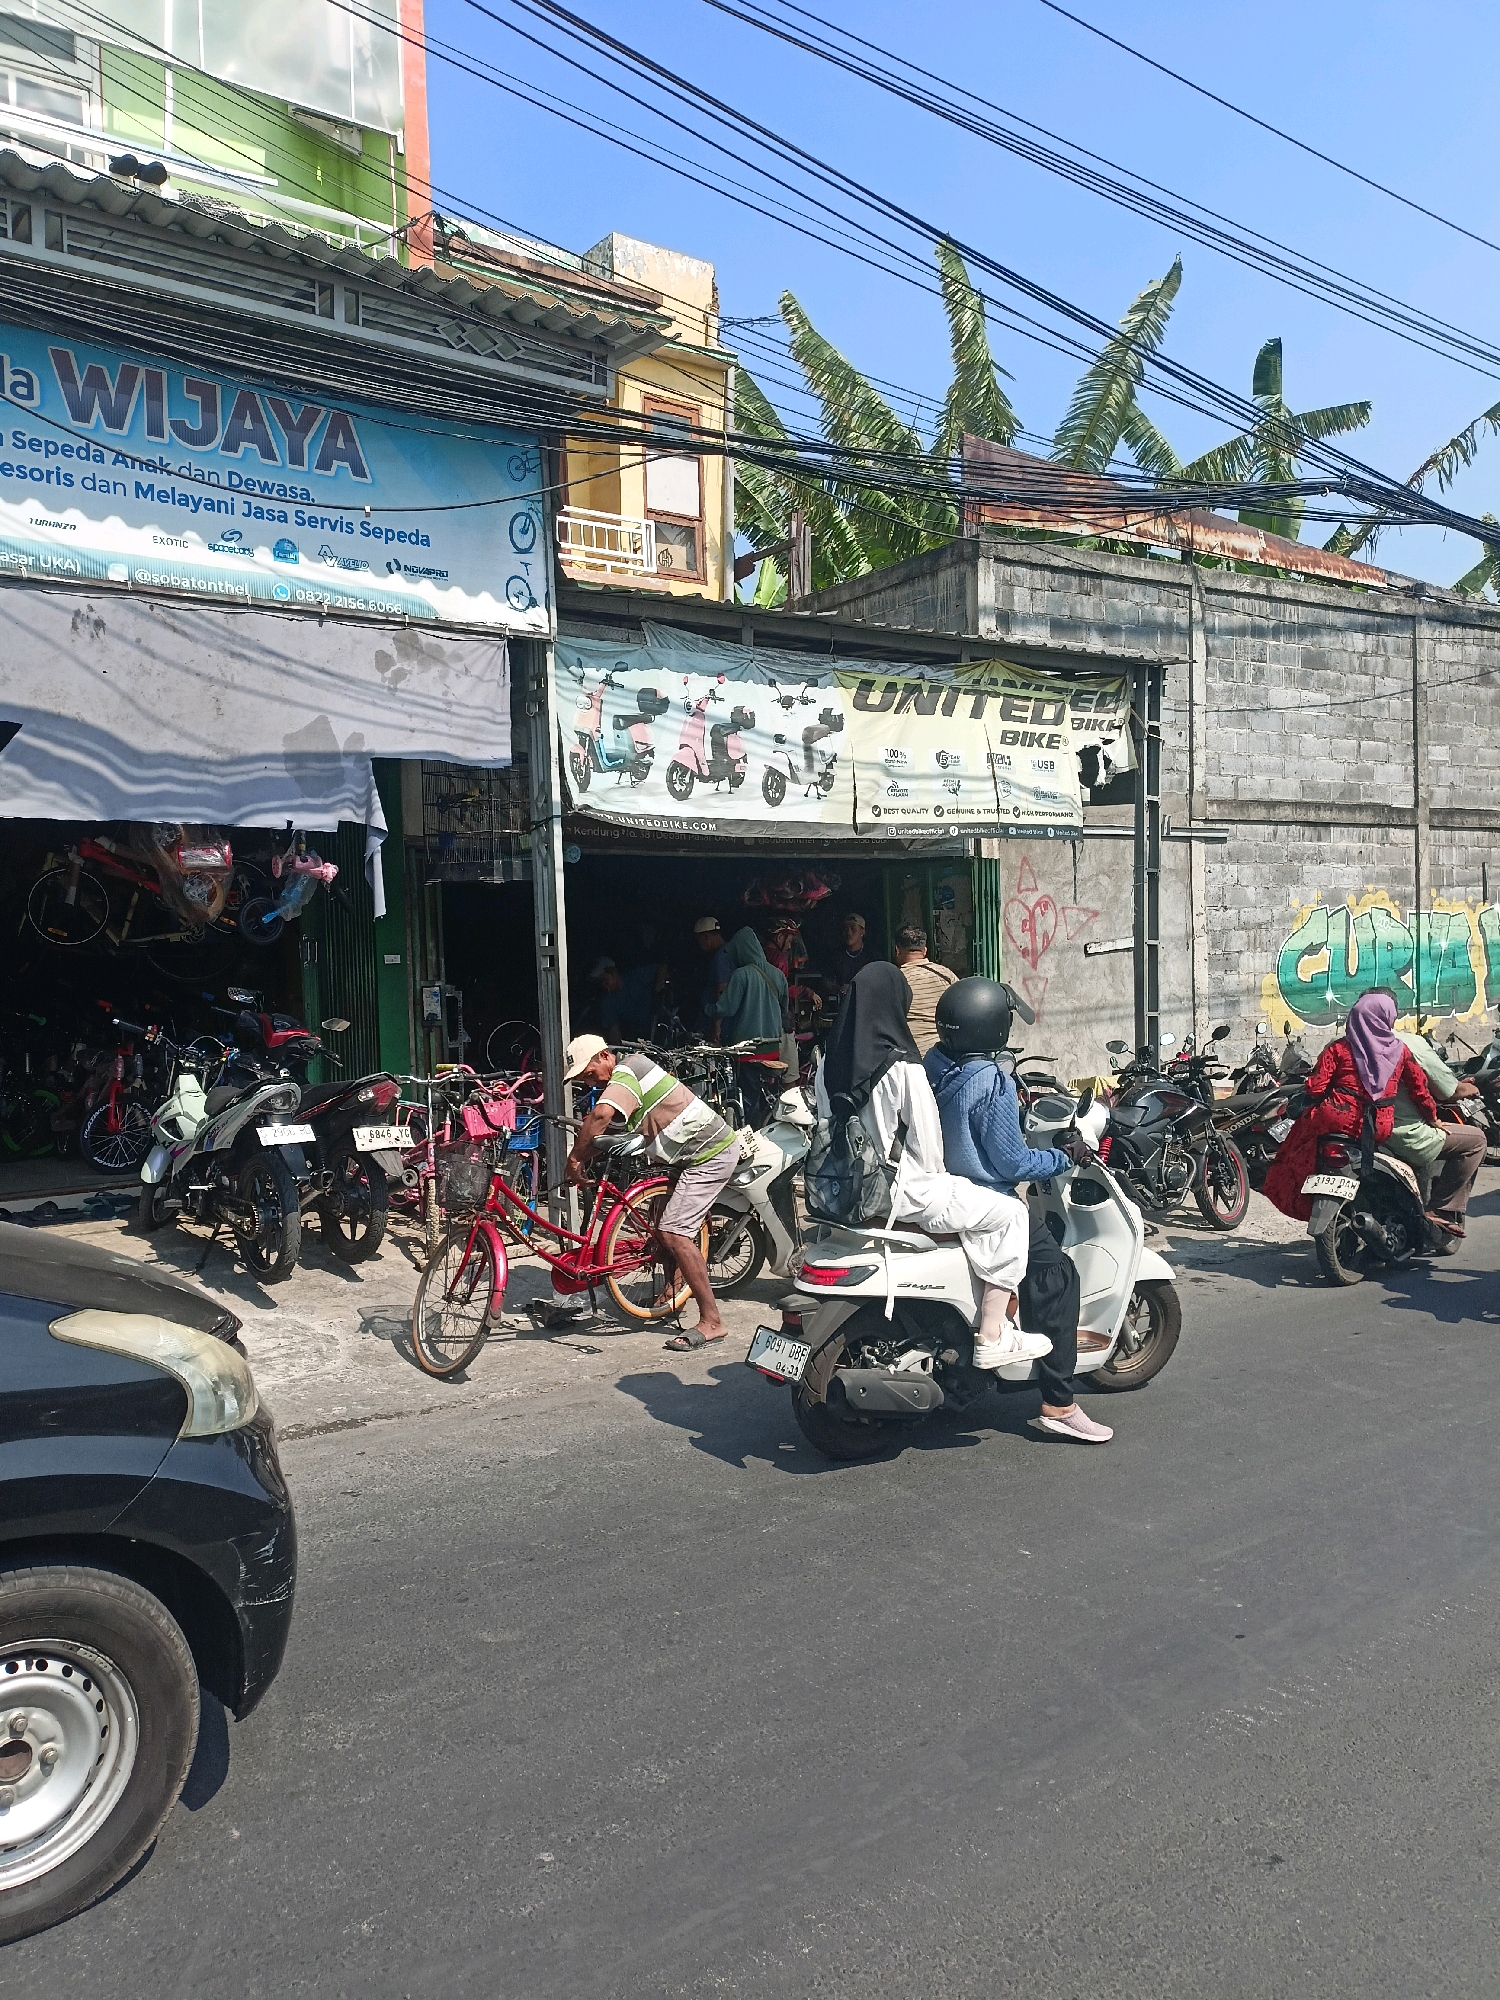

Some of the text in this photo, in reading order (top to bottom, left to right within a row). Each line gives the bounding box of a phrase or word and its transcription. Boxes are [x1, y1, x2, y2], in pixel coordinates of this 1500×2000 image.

[48, 346, 372, 484] WIJAYA
[11, 430, 105, 465] Sepeda
[111, 449, 172, 476] Anak
[177, 462, 220, 486] dan
[227, 470, 315, 503] Dewasa.
[80, 473, 127, 497] dan
[134, 480, 235, 515] Melayani
[242, 501, 289, 525] Jasa
[294, 509, 355, 535] Servis
[359, 520, 431, 548] Sepeda
[152, 536, 189, 549] EXOTIC
[39, 554, 80, 575] UKA)
[403, 564, 449, 578] NOVAPRO
[134, 568, 250, 597] @sobatonthel
[295, 589, 402, 615] 0822 2156 6066
[853, 678, 1067, 727] UNITED
[1037, 760, 1055, 770] USB
[574, 826, 620, 839] Kendung
[369, 1128, 392, 1139] 6846
[1315, 1176, 1336, 1186] 3193
[765, 1335, 787, 1355] 6091
